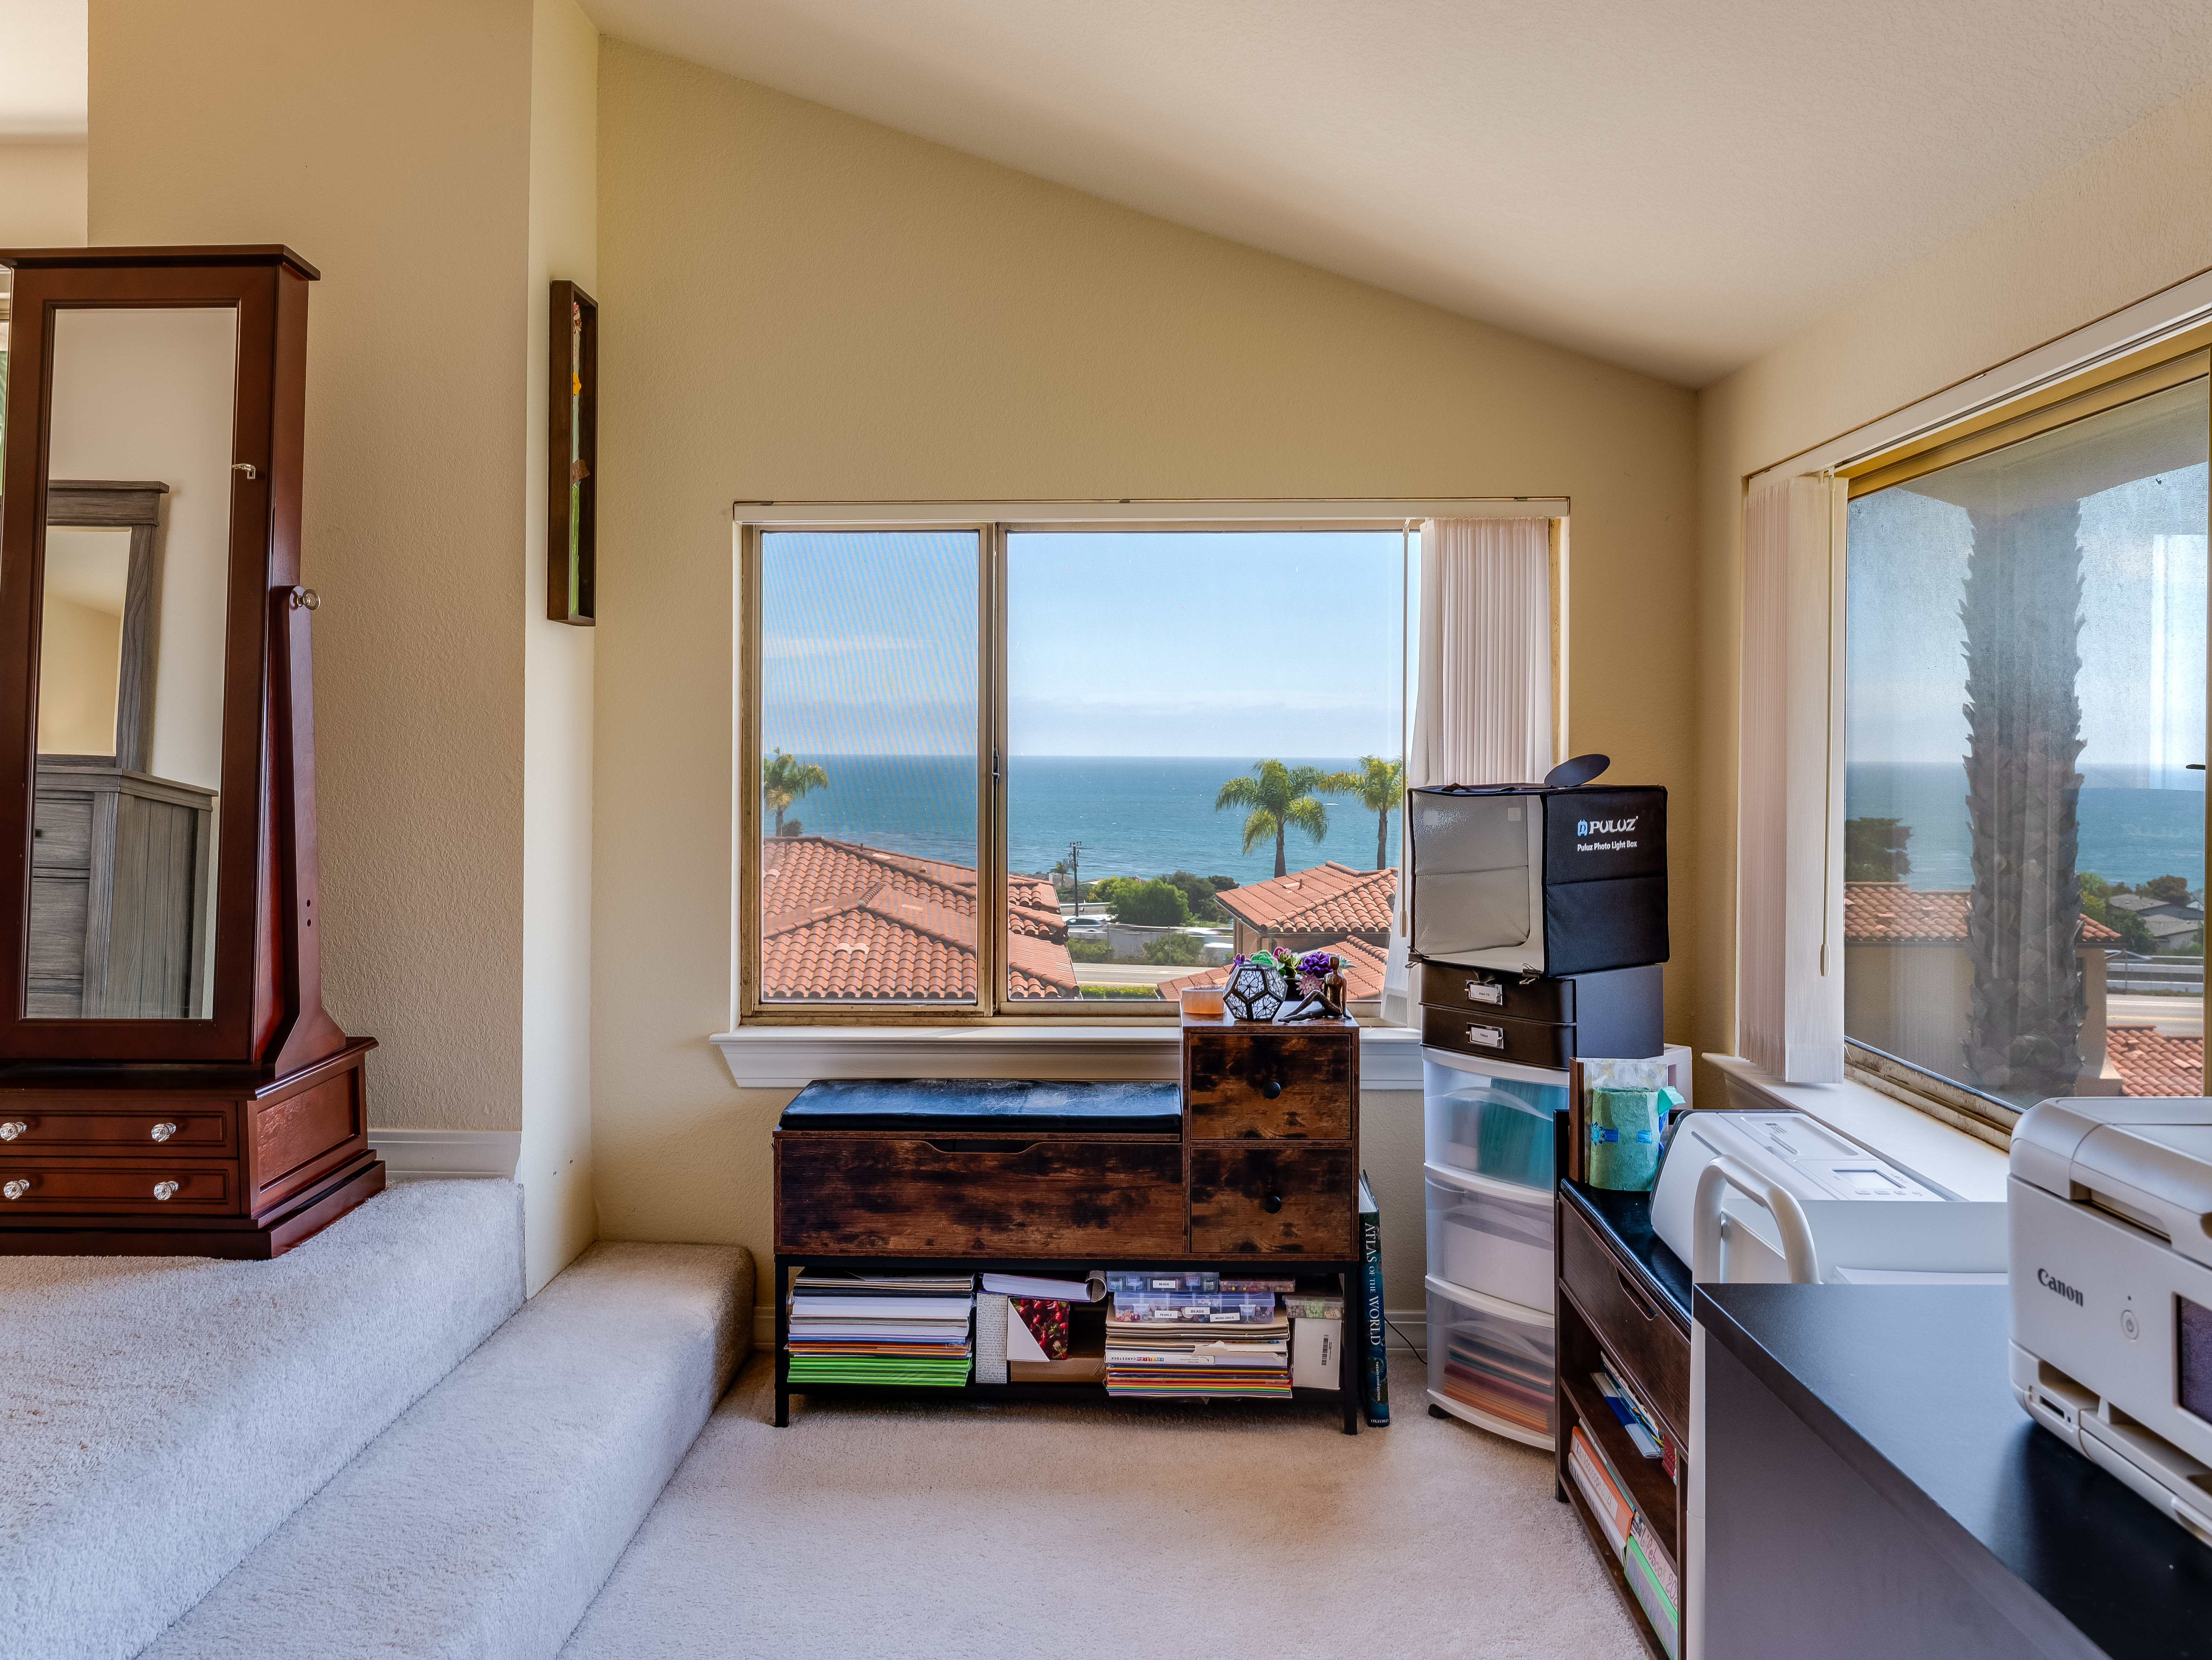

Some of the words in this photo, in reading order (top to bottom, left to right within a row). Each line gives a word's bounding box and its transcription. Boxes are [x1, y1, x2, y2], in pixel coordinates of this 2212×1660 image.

[1589, 819, 1636, 834] PULUZ
[1577, 843, 1593, 852] Puluz
[1594, 842, 1611, 851] Photo
[1612, 840, 1626, 851] Light
[1627, 840, 1637, 848] Box
[1365, 1222, 1377, 1262] ATLAS
[1369, 1266, 1375, 1276] OF
[2038, 1268, 2084, 1307] Canon
[1369, 1295, 1381, 1345] WORLD
